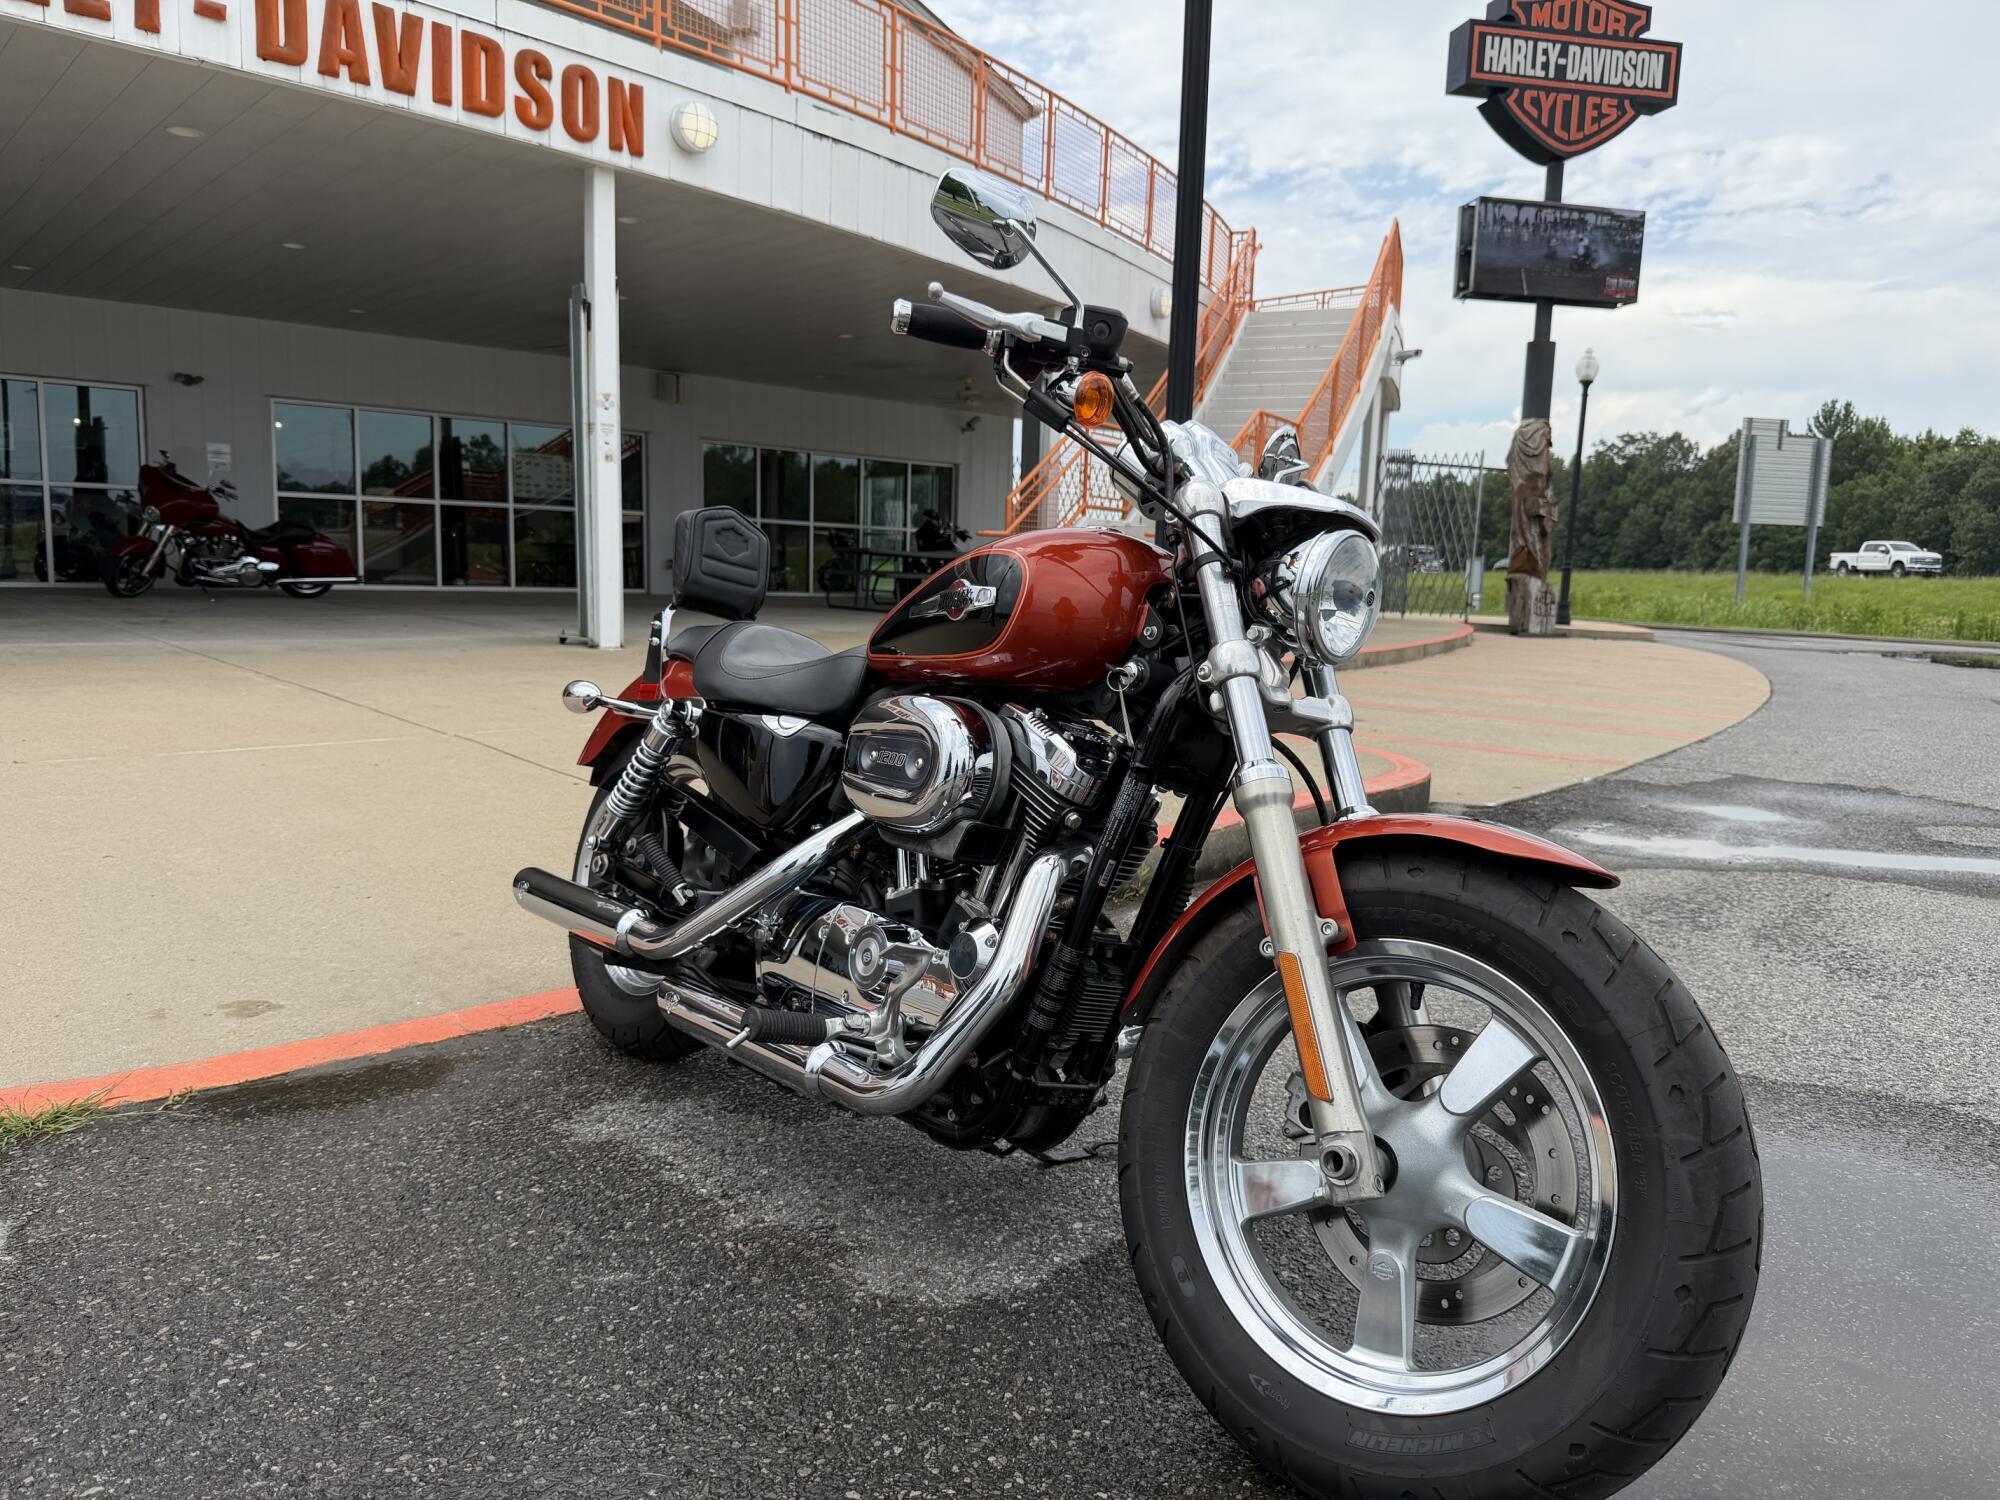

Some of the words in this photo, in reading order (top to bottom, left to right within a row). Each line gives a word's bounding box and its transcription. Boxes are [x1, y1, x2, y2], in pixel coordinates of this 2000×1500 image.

[1531, 0, 1626, 37] MOTOR
[1483, 34, 1665, 90] HARLEY-DAVIDSON
[1523, 89, 1619, 141] CYCLES
[876, 749, 907, 767] 1200
[1351, 1430, 1465, 1452] MICHELIN
